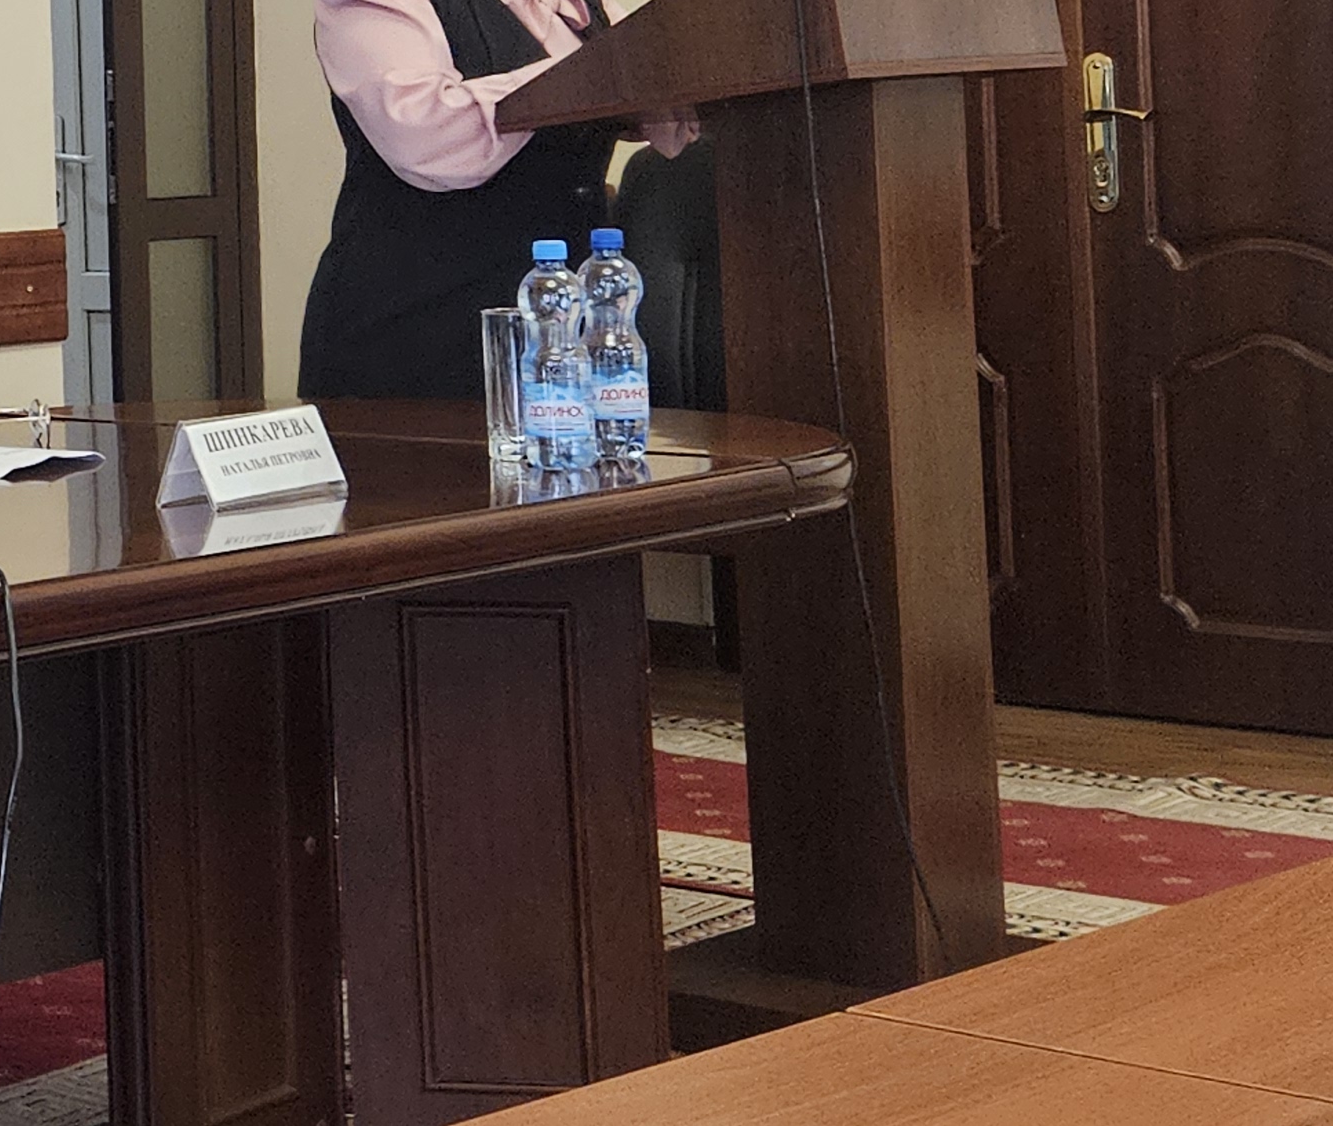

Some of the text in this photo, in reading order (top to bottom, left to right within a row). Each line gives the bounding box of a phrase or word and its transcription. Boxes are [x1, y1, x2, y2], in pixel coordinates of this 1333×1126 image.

[203, 416, 316, 453] ШИНКАРЕВА
[220, 448, 323, 477] НАТАЛЬЯ ПЕТРОВНА
